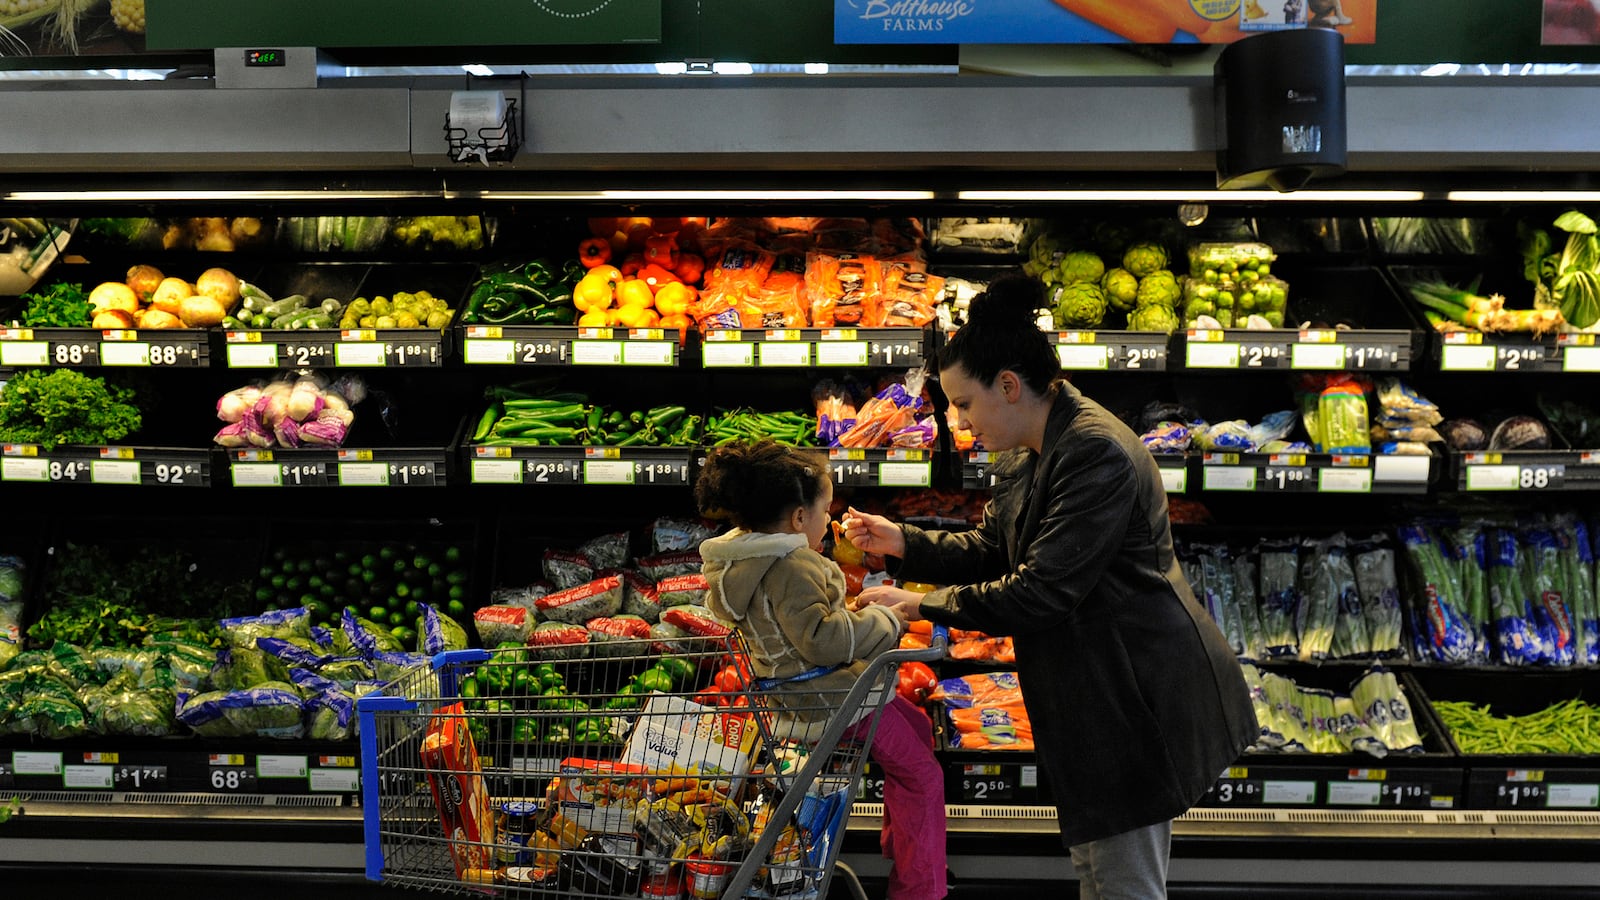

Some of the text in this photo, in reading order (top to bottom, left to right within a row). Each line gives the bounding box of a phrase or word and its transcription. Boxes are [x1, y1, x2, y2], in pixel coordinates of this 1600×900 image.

[883, 18, 943, 31] FARMS
[643, 727, 684, 750] Great
[648, 741, 678, 758] Value
